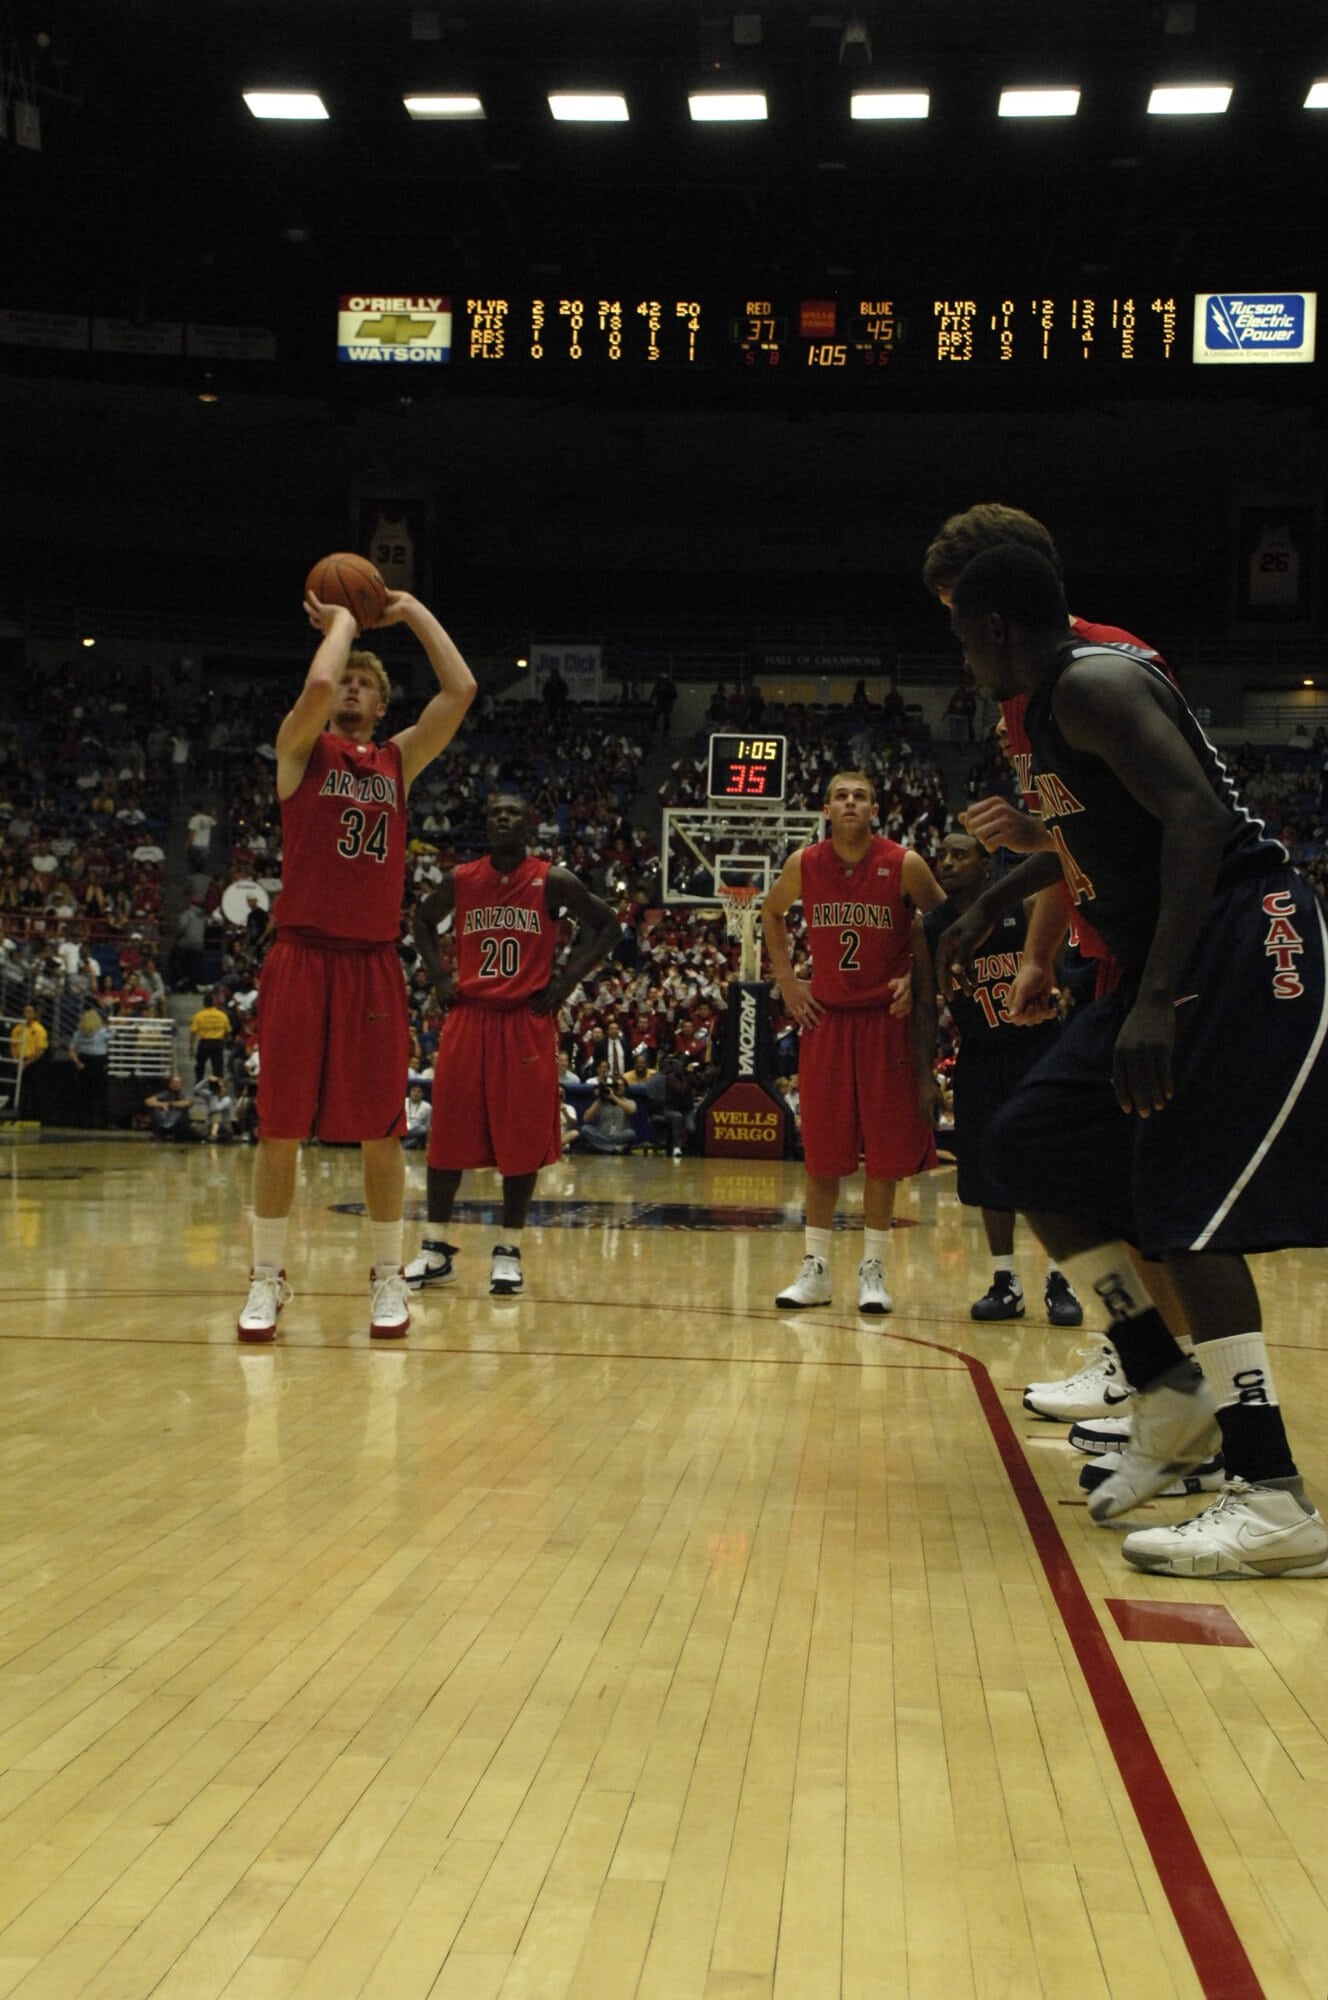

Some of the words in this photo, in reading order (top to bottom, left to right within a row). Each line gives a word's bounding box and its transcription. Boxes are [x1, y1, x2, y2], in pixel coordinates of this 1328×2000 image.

[348, 297, 443, 312] O'RIELLY
[466, 299, 509, 315] PLYR
[531, 300, 545, 315] 2
[558, 300, 584, 316] 20
[597, 300, 623, 316] 34
[637, 301, 662, 317] 42
[675, 301, 701, 317] 50
[746, 301, 771, 315] RED
[860, 301, 893, 315] BLUE
[934, 301, 976, 316] PLYR
[1001, 300, 1014, 315] 0
[1072, 300, 1095, 314] 13
[1112, 299, 1135, 314] 14
[1151, 299, 1176, 313] 44
[1229, 301, 1285, 315] Tucson
[473, 314, 505, 329] PTS
[531, 314, 545, 330] 3
[570, 315, 584, 330] 0
[599, 315, 622, 331] 18
[648, 316, 661, 332] 6
[687, 317, 700, 332] 4
[747, 320, 775, 340] 37
[941, 316, 971, 331] PTS
[1041, 315, 1054, 330] 6
[1112, 313, 1135, 329] 10
[1163, 313, 1176, 329] 5
[1234, 313, 1296, 329] Electric
[470, 329, 505, 345] RBS
[571, 330, 578, 345] 1
[608, 330, 622, 346] 0
[650, 331, 656, 346] 1
[689, 331, 695, 347] 1
[866, 320, 894, 341] 45
[938, 331, 973, 346] RBS
[1000, 330, 1013, 346] 0
[1043, 330, 1049, 345] 1
[1122, 329, 1135, 344] 5
[1239, 328, 1296, 342] Power
[348, 347, 442, 362] WATSON
[530, 344, 544, 359] 0
[569, 344, 583, 359] 0
[608, 344, 622, 360] 0
[647, 345, 660, 361] 3
[688, 346, 694, 361] 1
[808, 344, 848, 366] 1:05
[938, 346, 973, 361] FLS
[1000, 345, 1013, 360] 3
[1042, 345, 1048, 360] 1
[1121, 344, 1134, 359] 2
[1164, 344, 1170, 358] 1
[377, 543, 406, 565] 32
[764, 655, 794, 665] HALL
[737, 740, 778, 760] 1:05
[724, 763, 768, 793] 35
[337, 807, 389, 863] 34
[462, 906, 542, 935] ARIZONA
[812, 902, 894, 929] ARIZONA
[839, 928, 861, 971] 2
[1262, 890, 1304, 1000] CATS
[478, 936, 520, 978] 20
[738, 988, 757, 1076] ARIZONA
[711, 1111, 778, 1127] WELLS
[714, 1127, 777, 1142] FARGO
